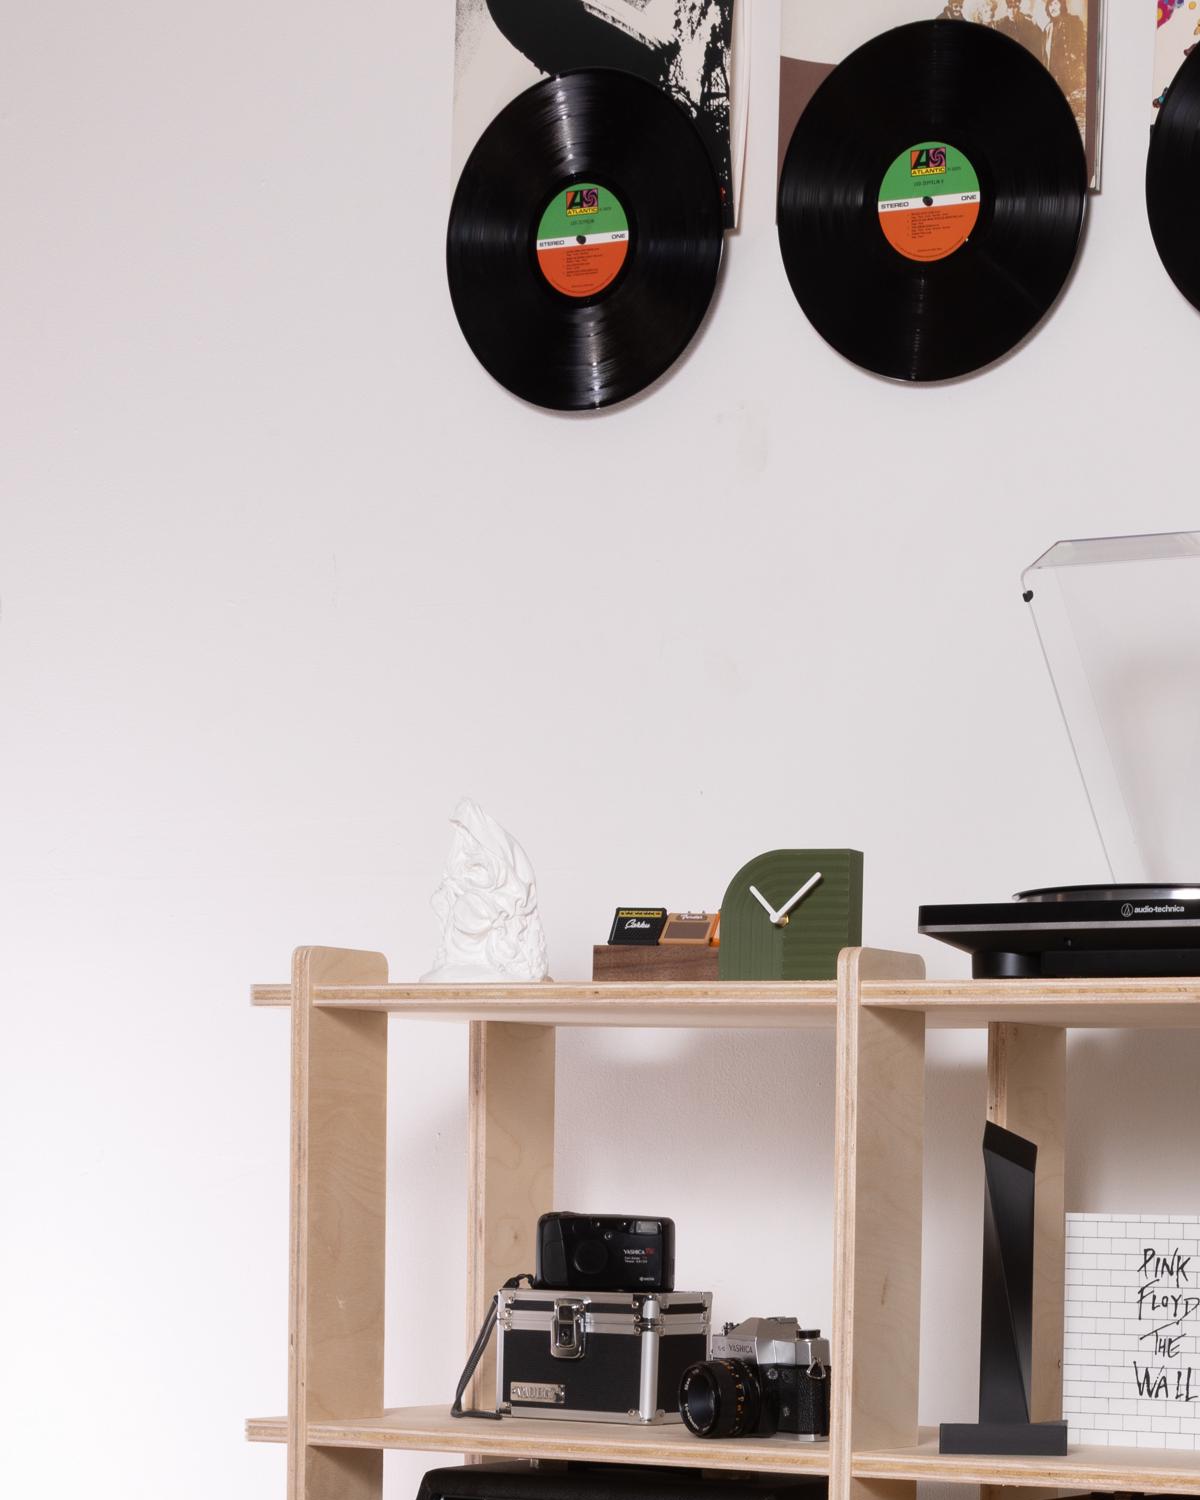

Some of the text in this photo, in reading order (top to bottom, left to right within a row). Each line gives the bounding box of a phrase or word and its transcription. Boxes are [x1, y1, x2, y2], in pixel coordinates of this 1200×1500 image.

[912, 167, 945, 176] ATLANTIC
[880, 201, 909, 210] STEREO
[567, 207, 598, 216] ATLANTIC
[1134, 904, 1185, 914] audio-technica
[1138, 1248, 1191, 1288] PINK
[1136, 1278, 1200, 1325] FLOYD
[1140, 1321, 1186, 1358] THE
[728, 1344, 753, 1354] YASHICA
[1133, 1360, 1199, 1402] WALL
